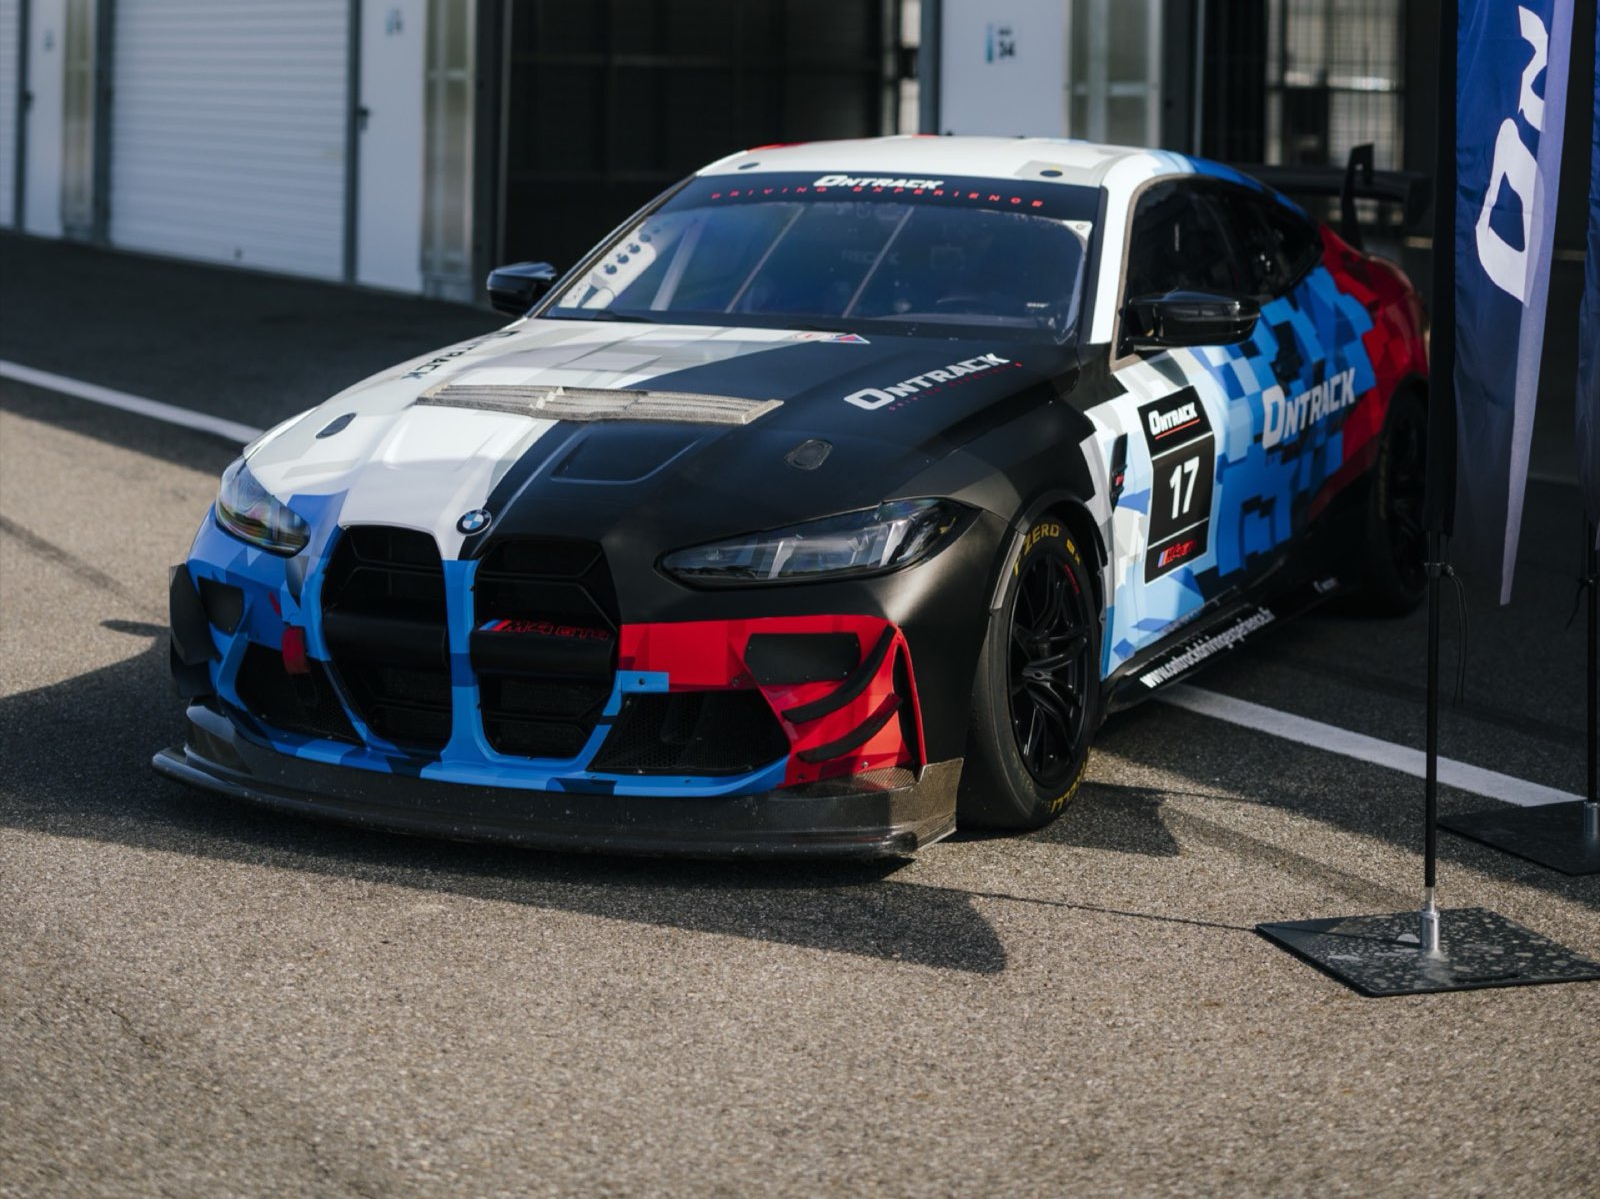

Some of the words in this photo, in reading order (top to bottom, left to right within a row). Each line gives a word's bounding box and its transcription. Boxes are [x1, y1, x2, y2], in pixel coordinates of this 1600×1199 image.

[711, 186, 828, 200] DRIVING
[852, 185, 1044, 208] EXPERIENCE
[813, 174, 945, 191] ONTRACK
[843, 353, 1011, 411] ONTRACK
[1148, 401, 1198, 436] ONTRACK
[1262, 367, 1356, 450] ONTRACK
[1169, 456, 1200, 520] 17
